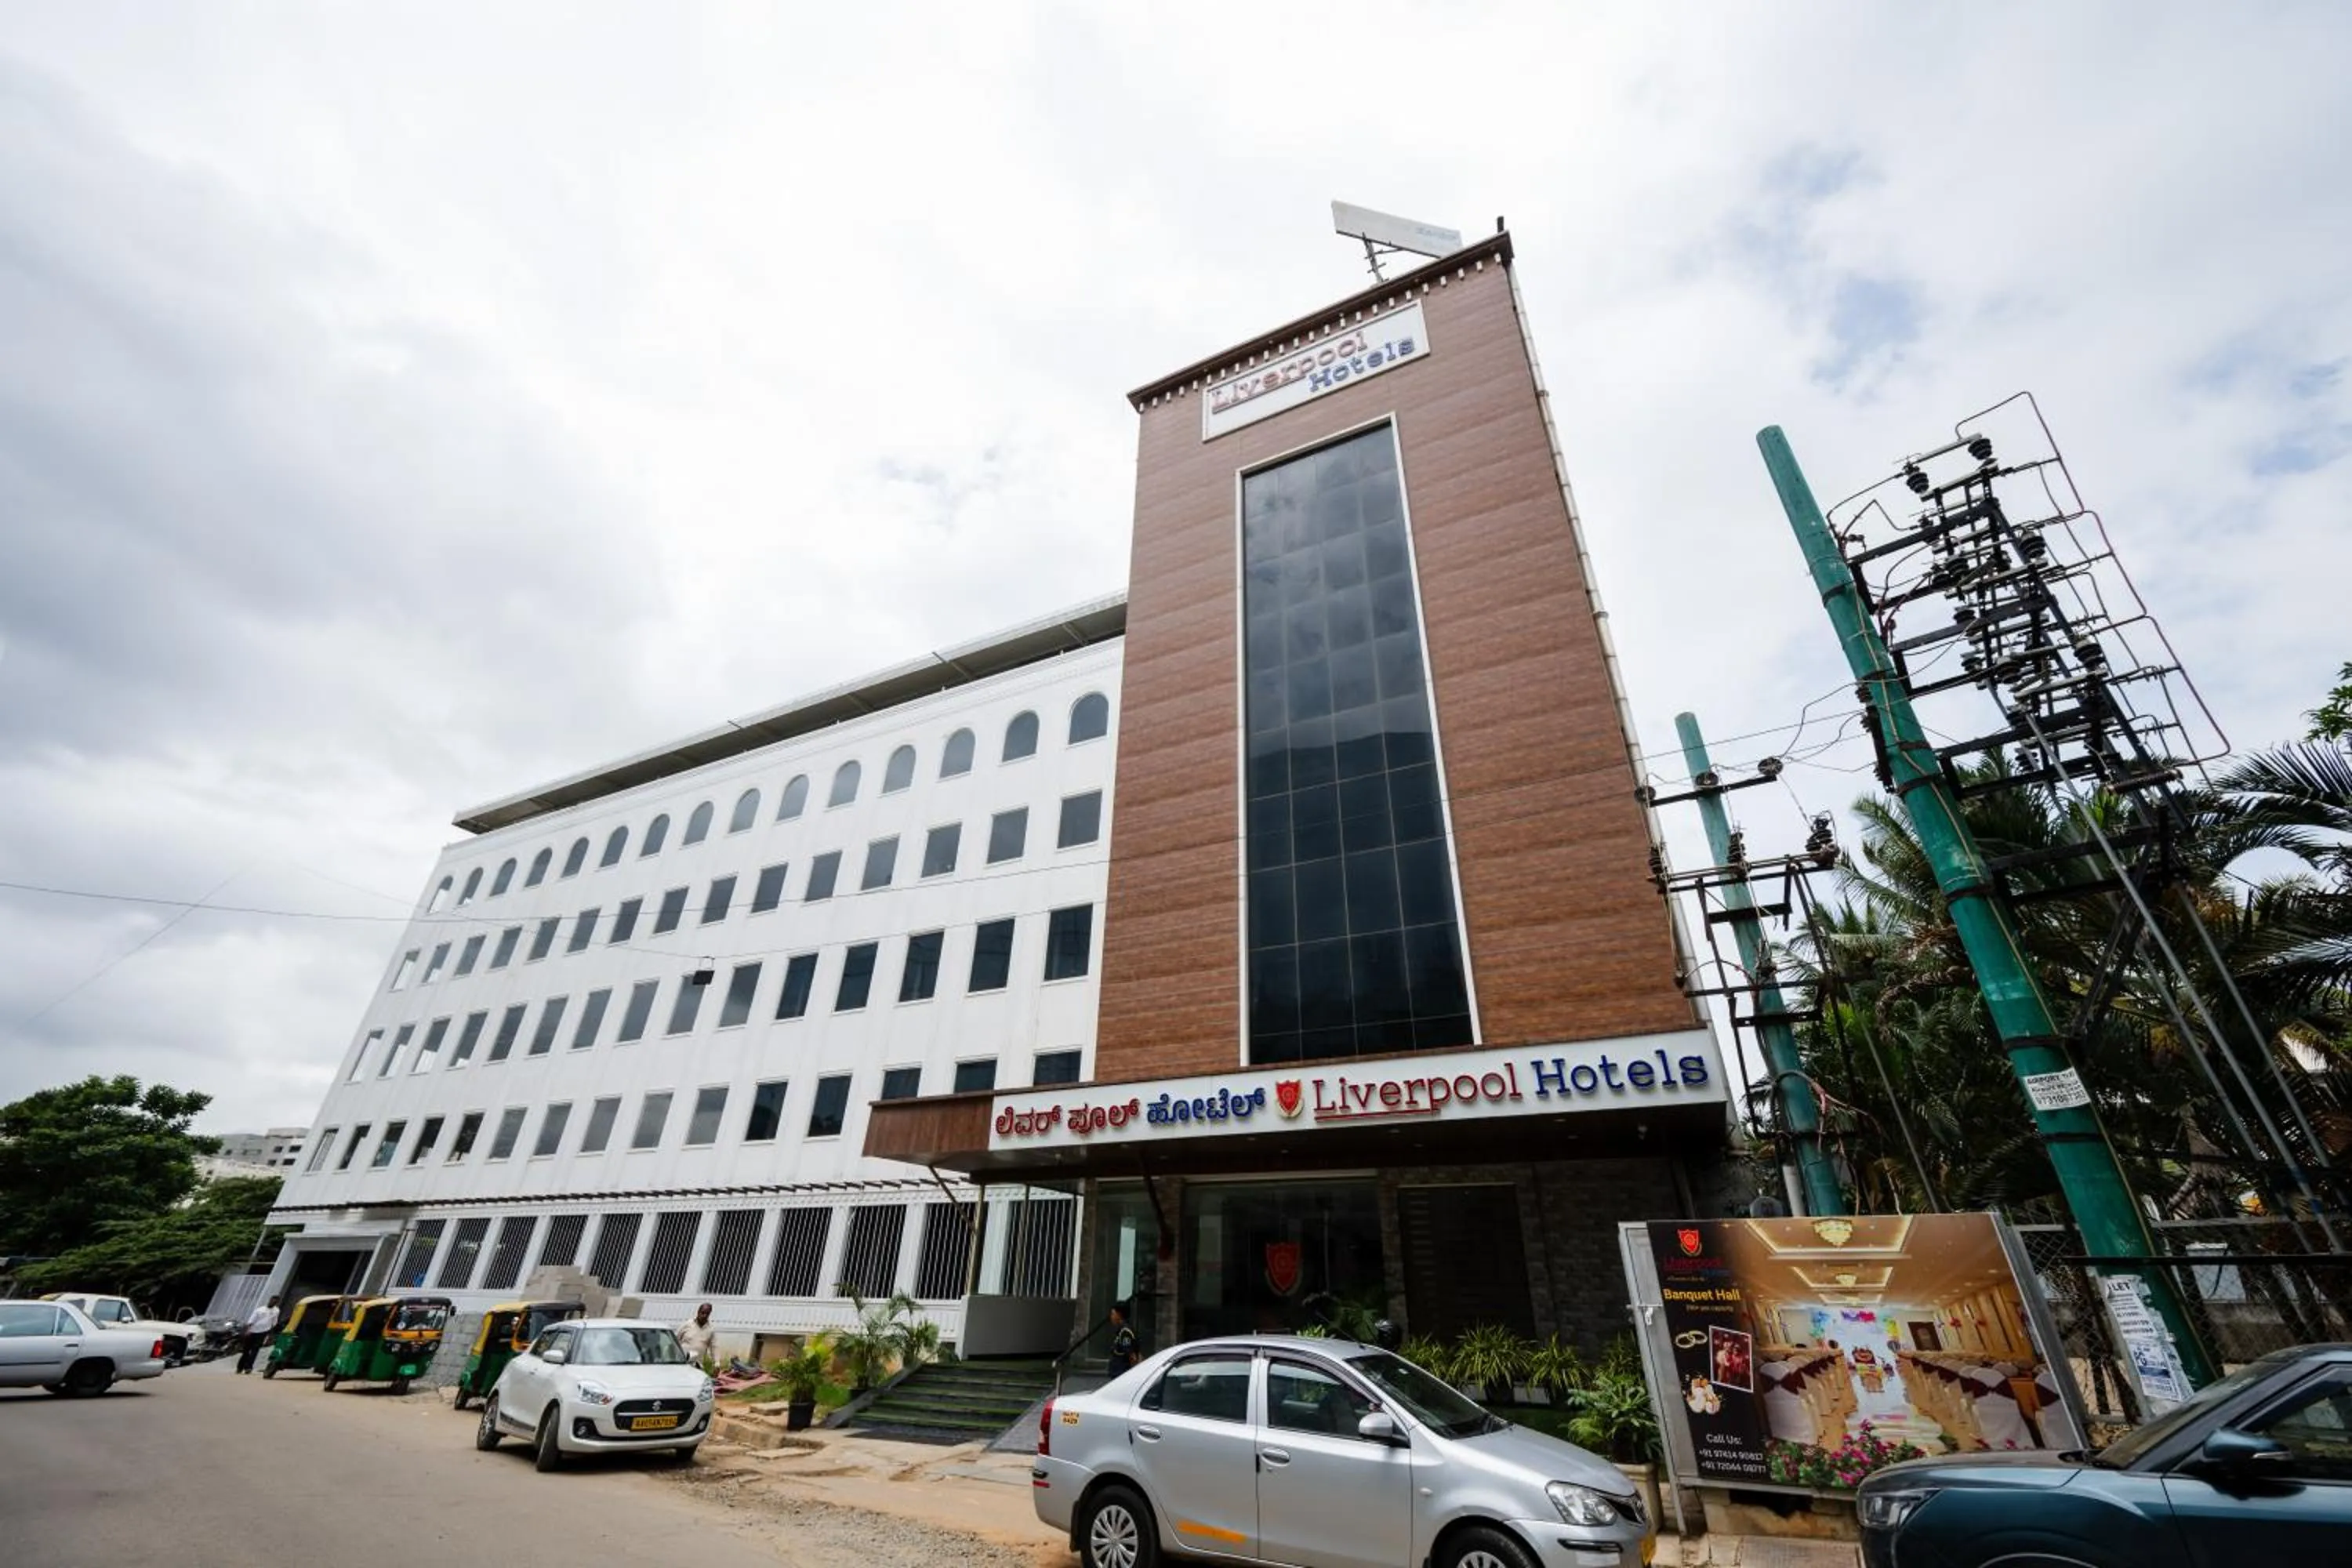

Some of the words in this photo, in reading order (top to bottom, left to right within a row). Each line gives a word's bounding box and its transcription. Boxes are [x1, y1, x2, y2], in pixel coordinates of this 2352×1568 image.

[1210, 330, 1368, 410] Liverpool
[1309, 336, 1415, 392] Hotels
[1147, 1087, 1266, 1123] ಹೋಟೆಲ್
[1312, 1062, 1523, 1114] Liverpool
[1531, 1050, 1709, 1098] Hotels
[1663, 1288, 1714, 1302] Banquet
[1715, 1288, 1741, 1301] Hall
[1705, 1434, 1725, 1443] Call
[1726, 1434, 1743, 1445] Us:
